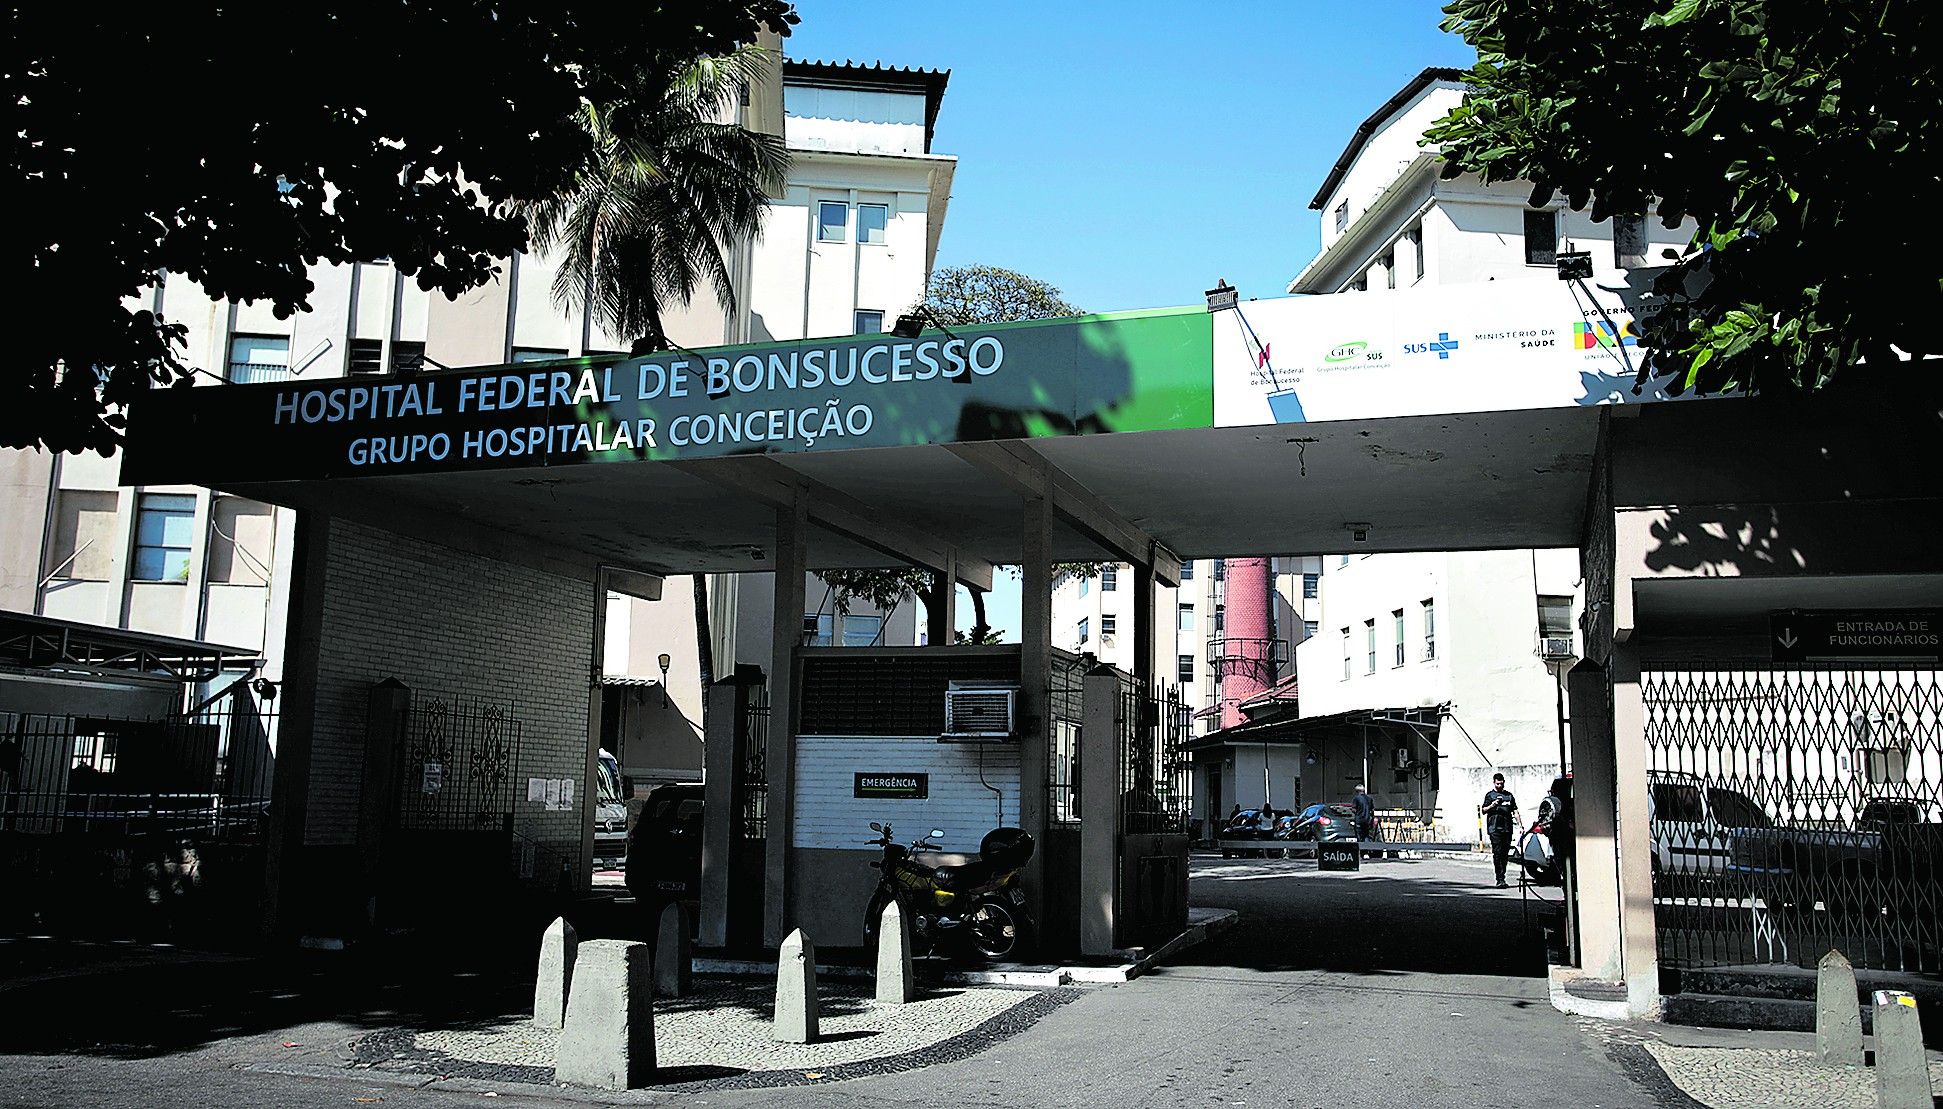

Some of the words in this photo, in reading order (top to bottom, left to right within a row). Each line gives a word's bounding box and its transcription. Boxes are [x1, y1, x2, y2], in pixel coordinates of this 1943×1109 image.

[1475, 330, 1536, 340] MINISTÉRIO
[1403, 343, 1428, 354] SUS
[1520, 339, 1555, 348] SAÚDE
[1366, 352, 1383, 360] SUS
[274, 382, 442, 425] HOSPITAL
[458, 367, 622, 413] FEDERAL
[638, 361, 690, 400] DE
[706, 336, 1004, 395] BONSUCESSO
[348, 432, 450, 466] GRUPO
[462, 419, 657, 459] HOSPITALAR
[669, 398, 874, 447] CONCEIÇÃO
[1836, 621, 1905, 632] ENTRADA
[1909, 621, 1929, 631] DE
[1829, 633, 1939, 645] FUNCIONÁRIOS
[861, 777, 917, 788] EMERGÊNCIA
[1323, 850, 1354, 861] SAÍDA
